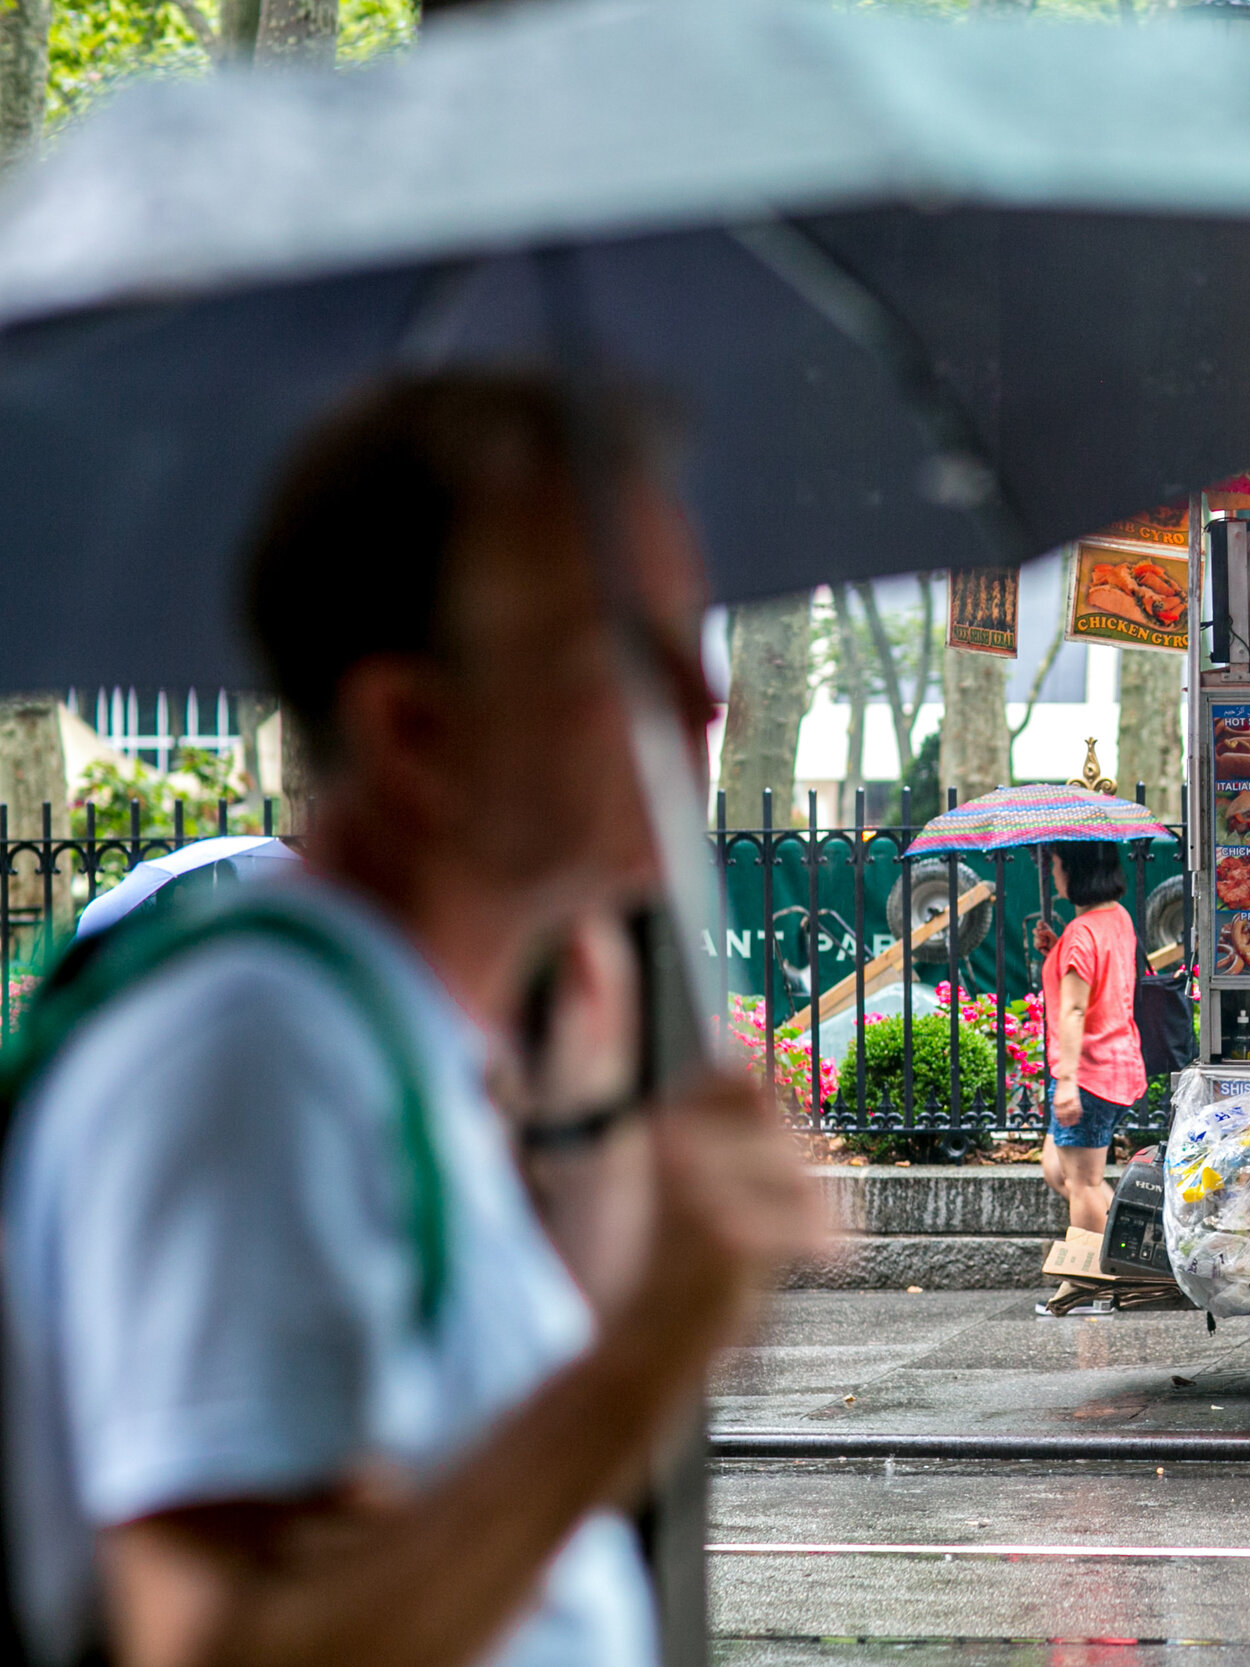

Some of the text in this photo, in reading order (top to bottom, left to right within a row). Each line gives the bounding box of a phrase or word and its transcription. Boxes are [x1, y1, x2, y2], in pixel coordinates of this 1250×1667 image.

[1138, 526, 1185, 545] GYRO
[1076, 615, 1150, 642] CHICKEN
[1224, 717, 1246, 727] HOT
